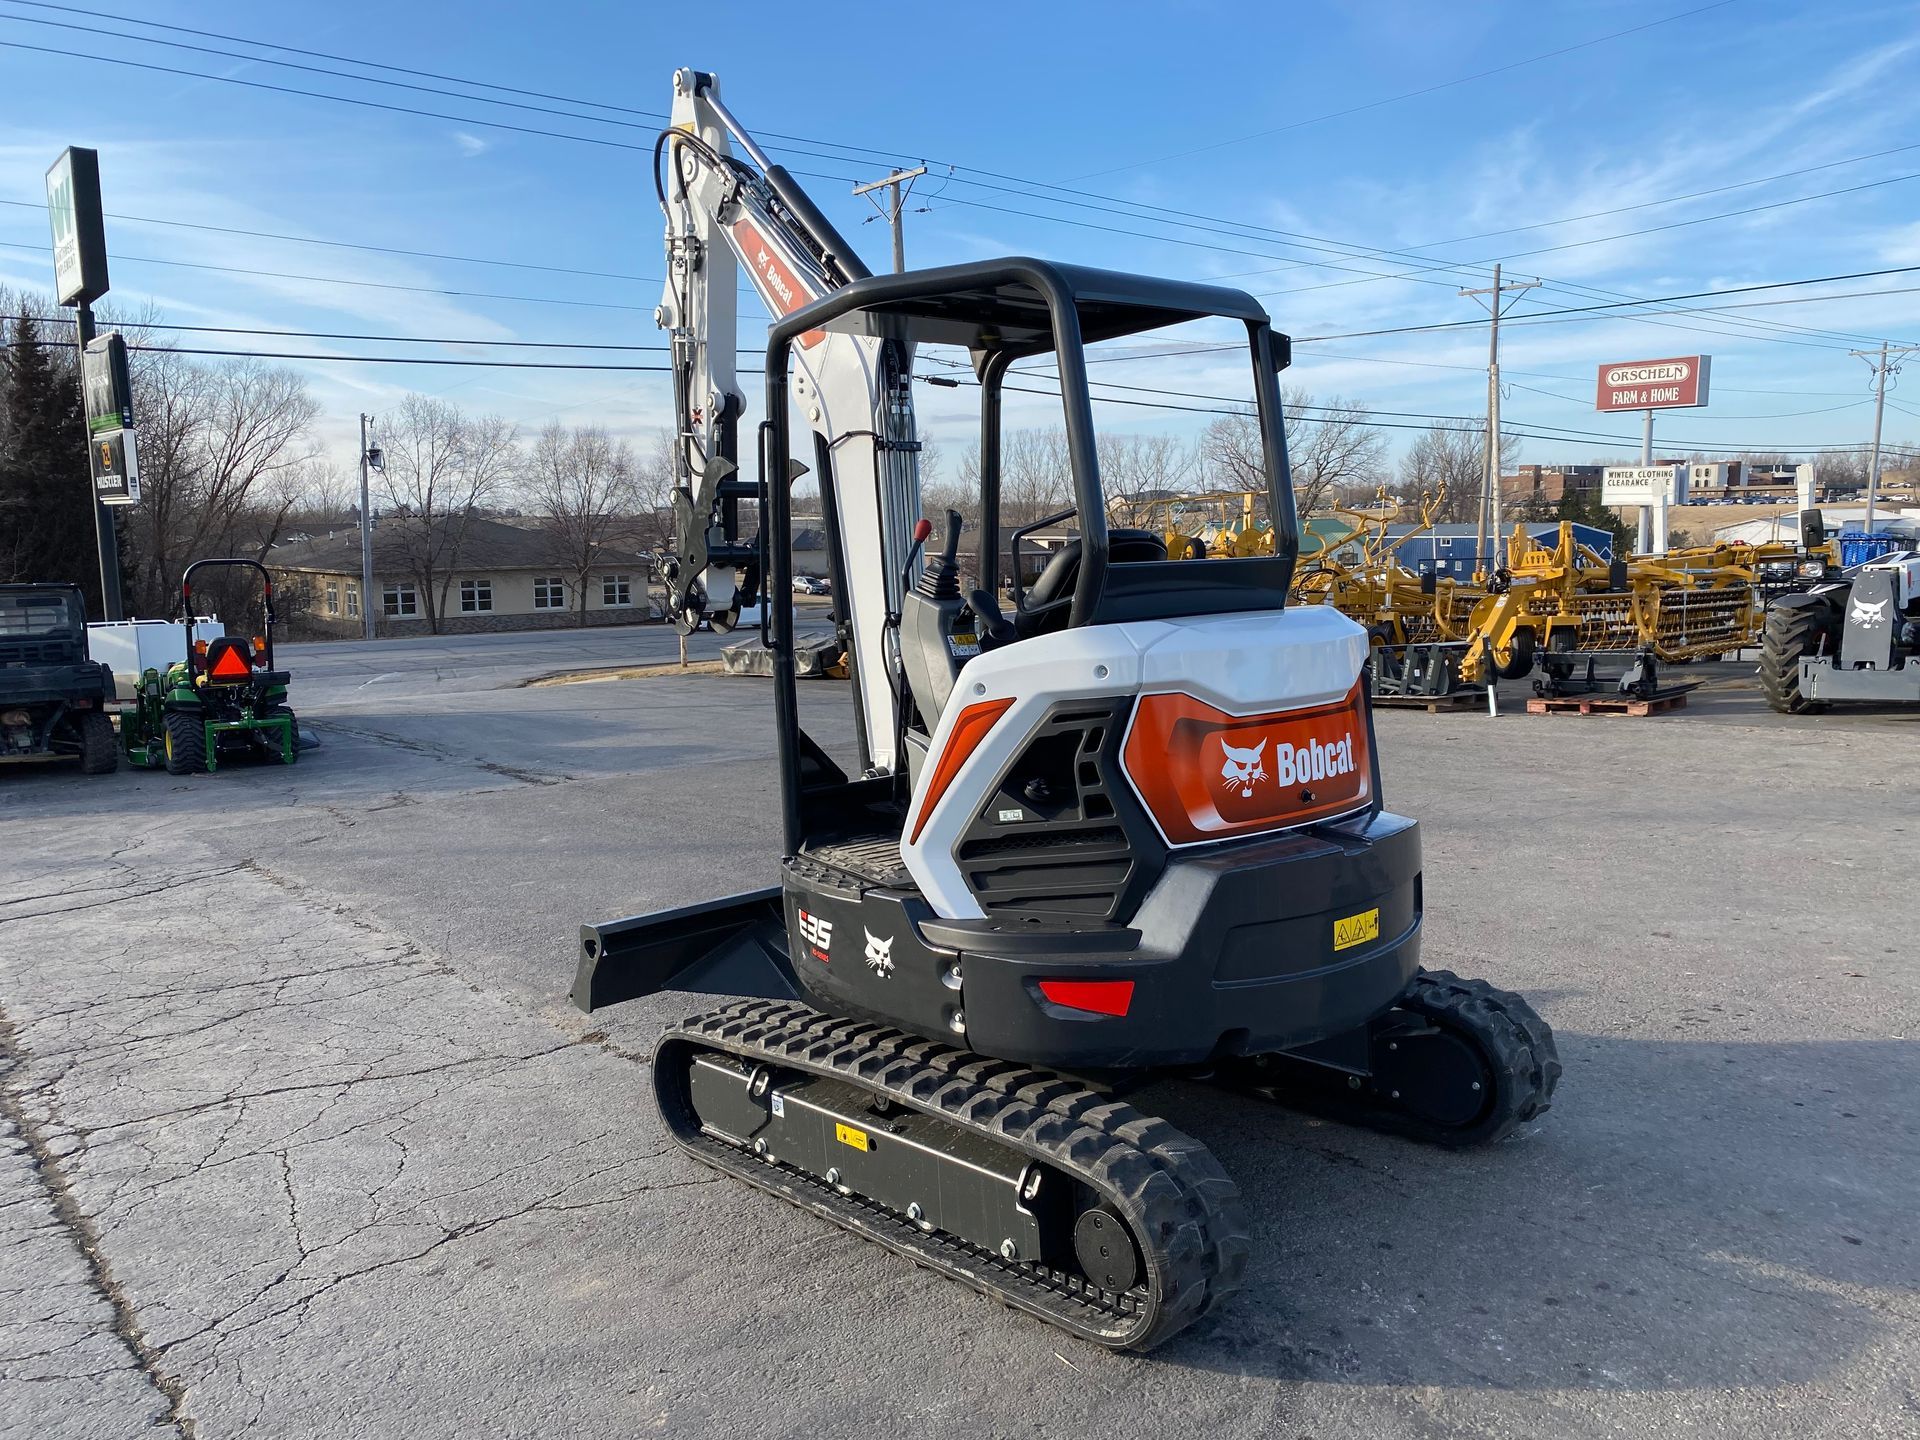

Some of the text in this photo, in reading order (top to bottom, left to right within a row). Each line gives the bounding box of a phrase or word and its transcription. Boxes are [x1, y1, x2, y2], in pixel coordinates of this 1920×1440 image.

[767, 264, 793, 308] Bobcat
[1610, 366, 1684, 382] ORSCHELN
[1612, 387, 1680, 405] FARM & HOME
[96, 474, 123, 489] HUSTLER
[1607, 479, 1649, 487] CLEARANCE
[1608, 470, 1674, 479] WINTER CLOTHING
[1276, 732, 1355, 788] Bobcat
[798, 908, 833, 951] E35
